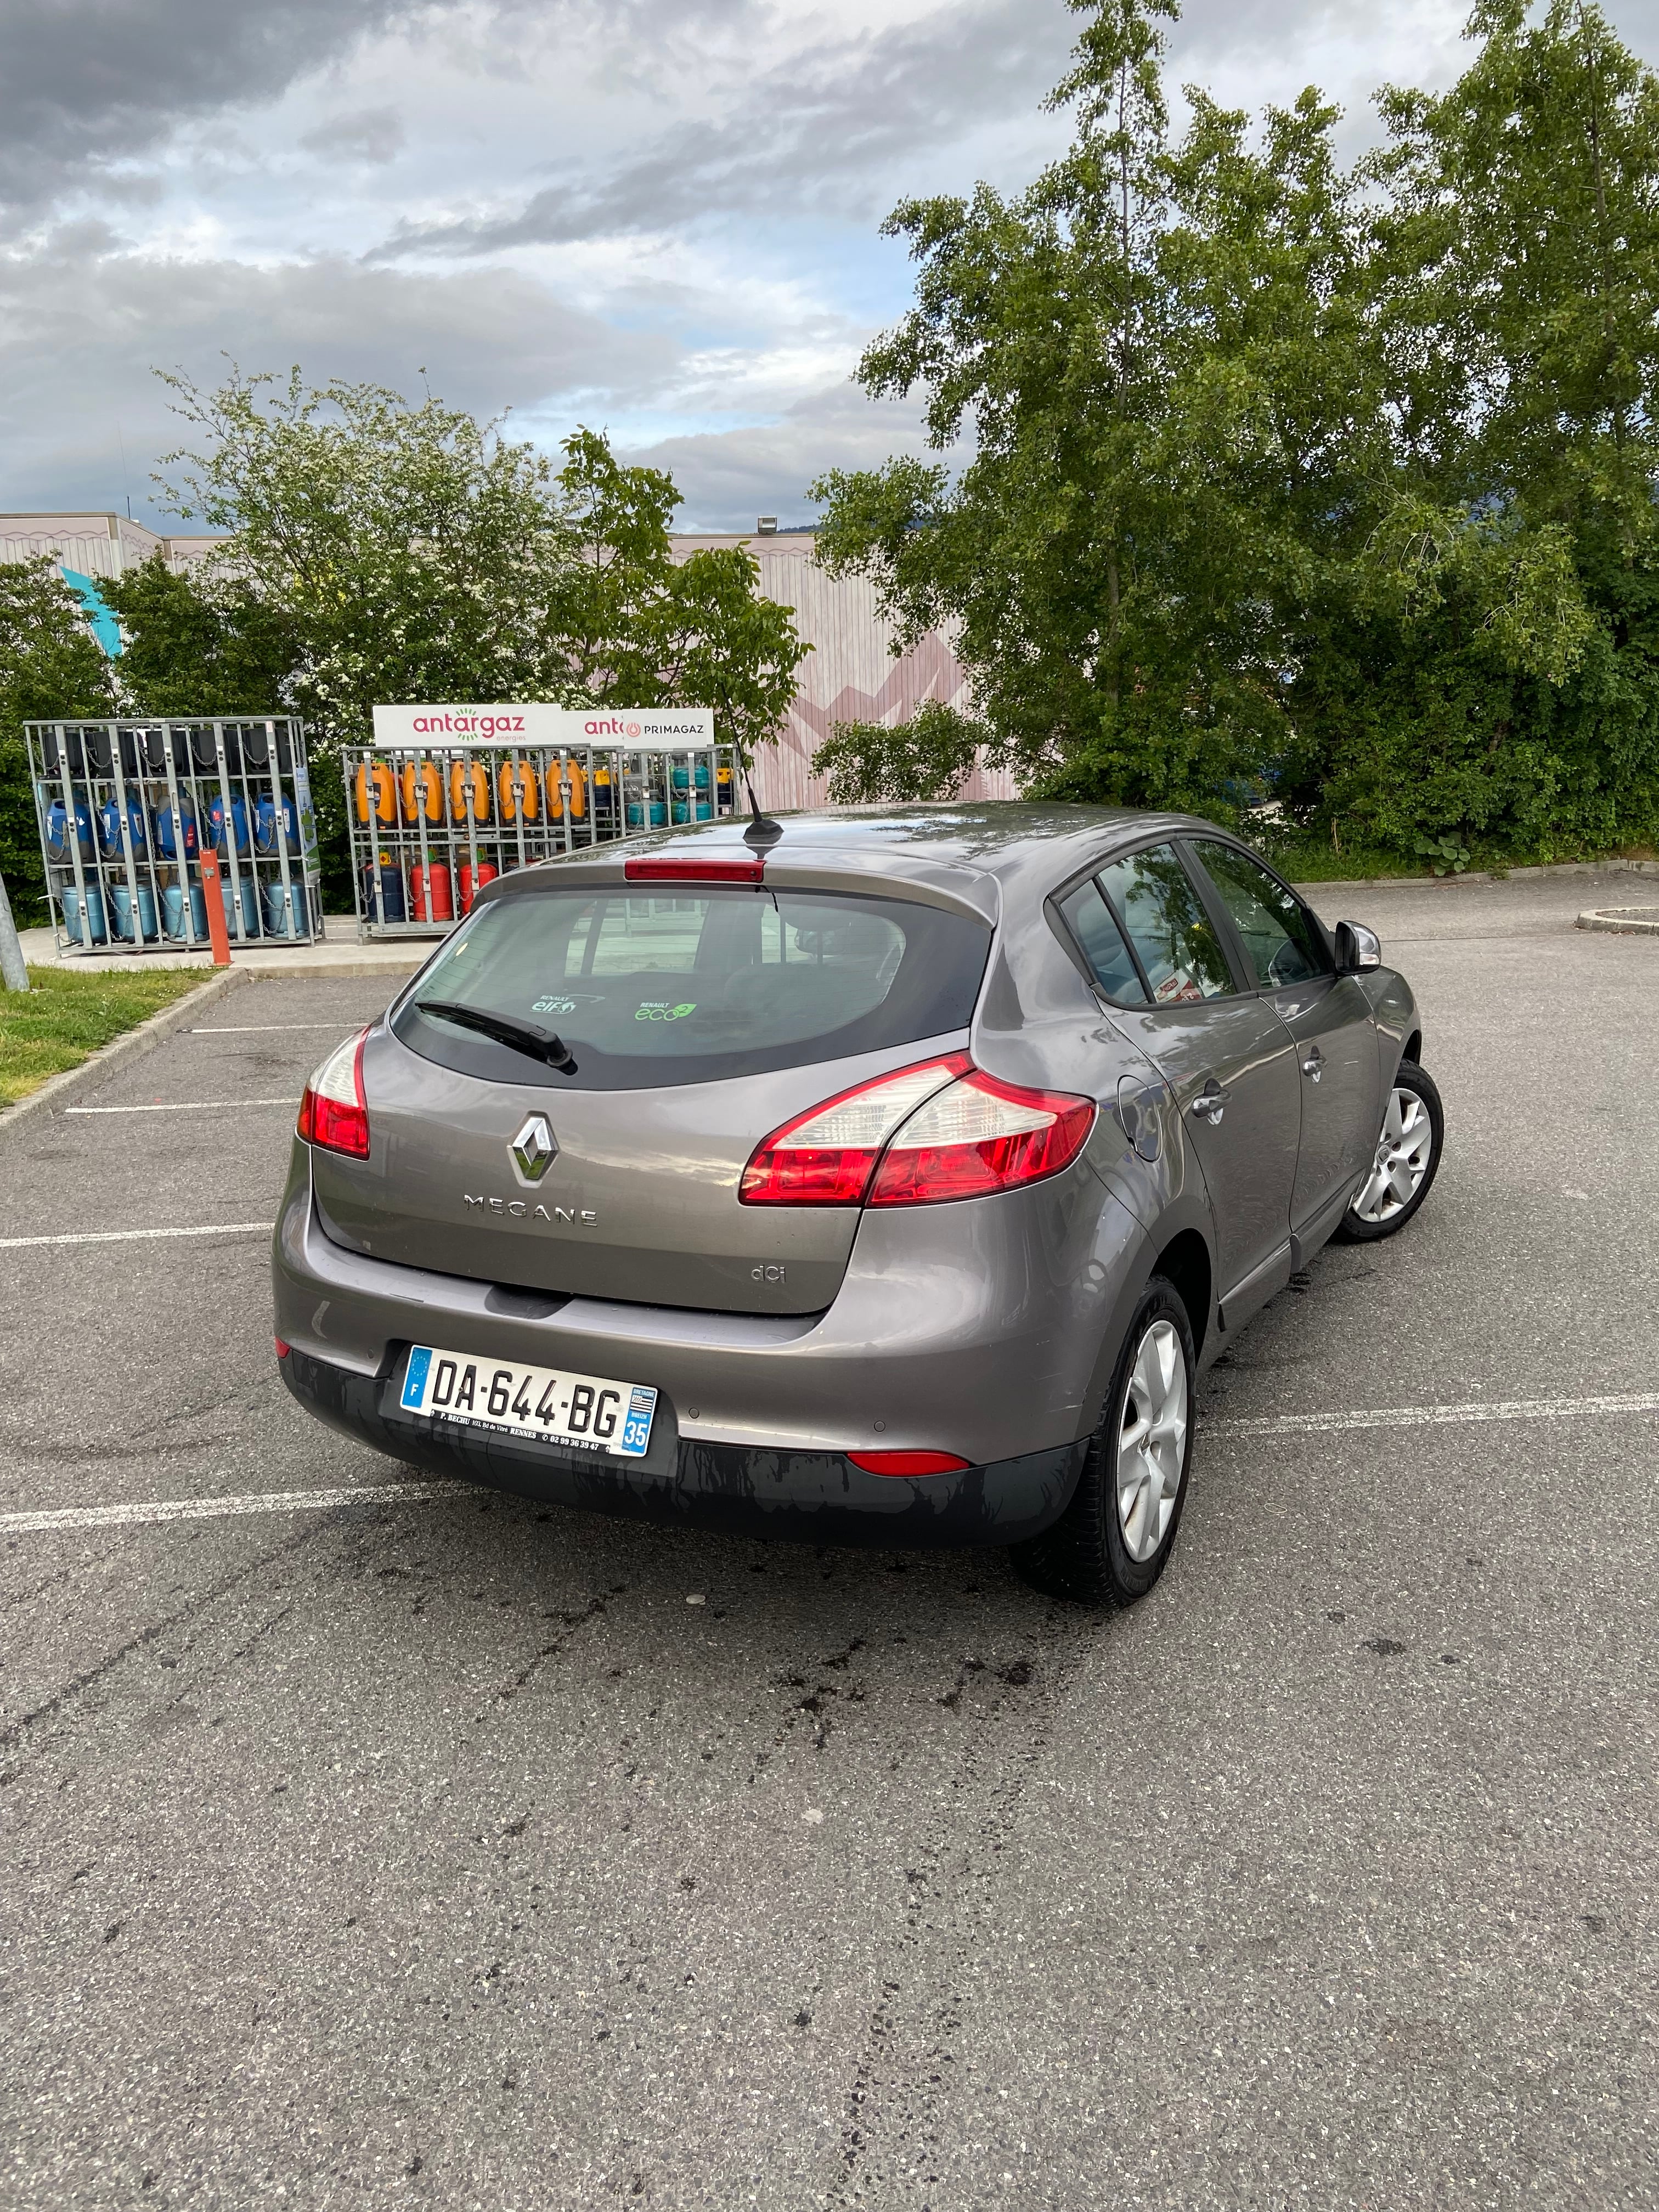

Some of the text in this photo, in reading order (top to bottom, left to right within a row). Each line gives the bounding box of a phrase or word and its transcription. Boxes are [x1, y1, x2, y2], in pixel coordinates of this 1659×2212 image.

[413, 713, 525, 738] antargaz
[644, 725, 704, 734] PRIMAGAZ
[531, 1001, 563, 1012] elf
[464, 1194, 597, 1228] MEGANE
[410, 1383, 419, 1396] F
[432, 1359, 620, 1438] DA-644-BG
[633, 1388, 654, 1397] BRETAGNE
[631, 1412, 647, 1420] BREIZH
[447, 1414, 470, 1425] BECHU
[510, 1427, 537, 1439] RENNES
[550, 1435, 560, 1443] 02
[624, 1421, 648, 1447] 35
